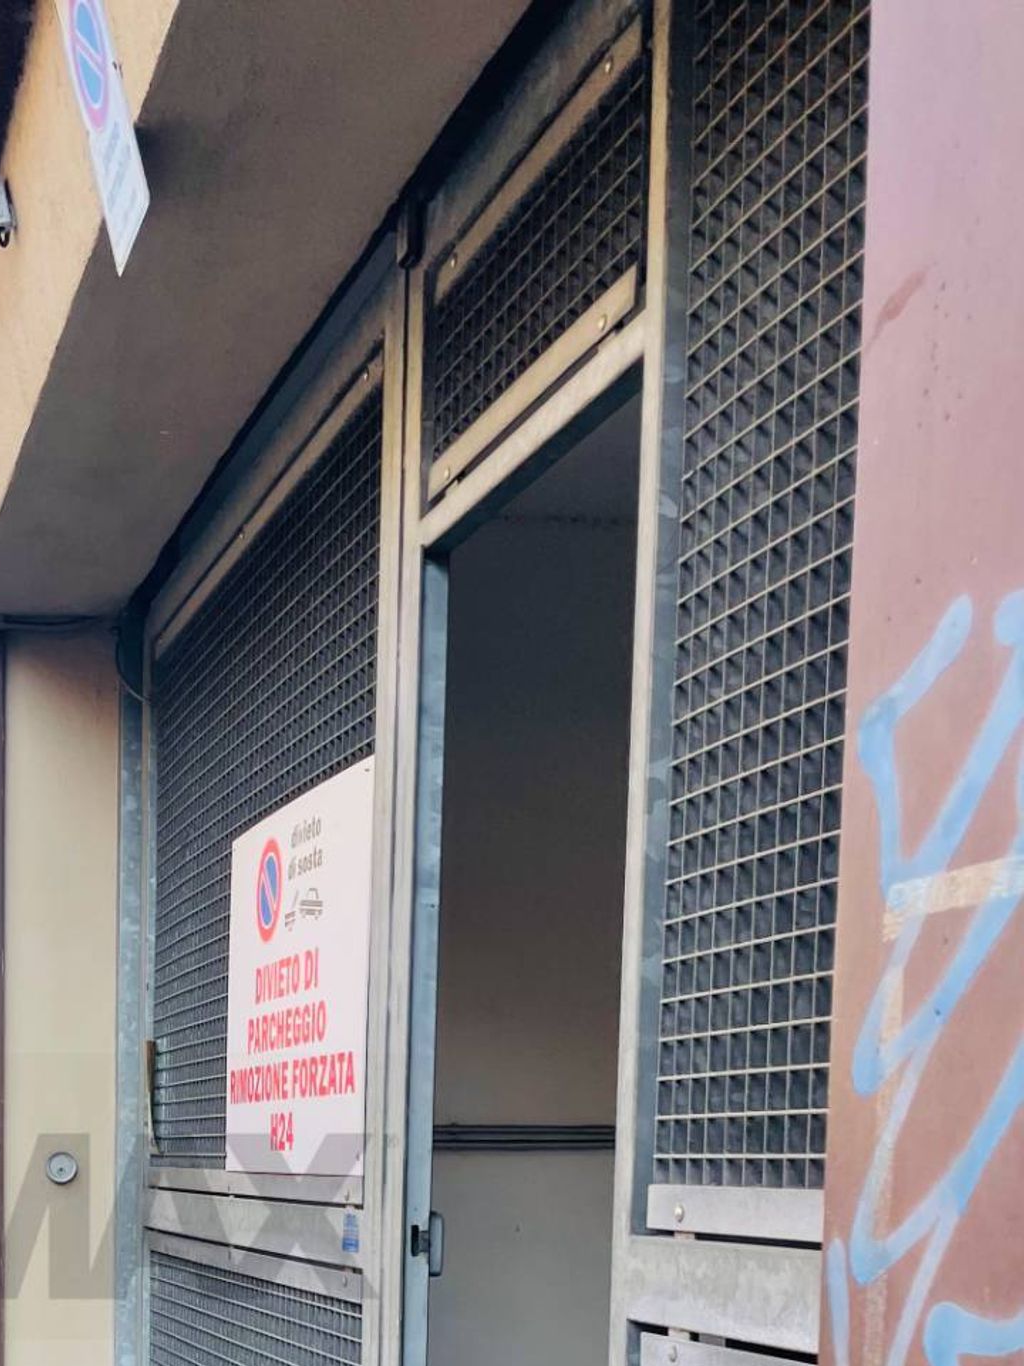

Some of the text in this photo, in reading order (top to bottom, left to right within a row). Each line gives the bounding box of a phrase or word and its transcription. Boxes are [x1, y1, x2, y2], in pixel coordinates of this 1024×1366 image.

[290, 815, 321, 848] divieto
[288, 846, 323, 880] di sosta
[255, 947, 320, 1005] DIVIETO DI
[247, 1000, 327, 1055] PARCHEGGIO
[230, 1051, 356, 1105] RIMOZIONE FORZATA
[270, 1112, 295, 1151] H24
